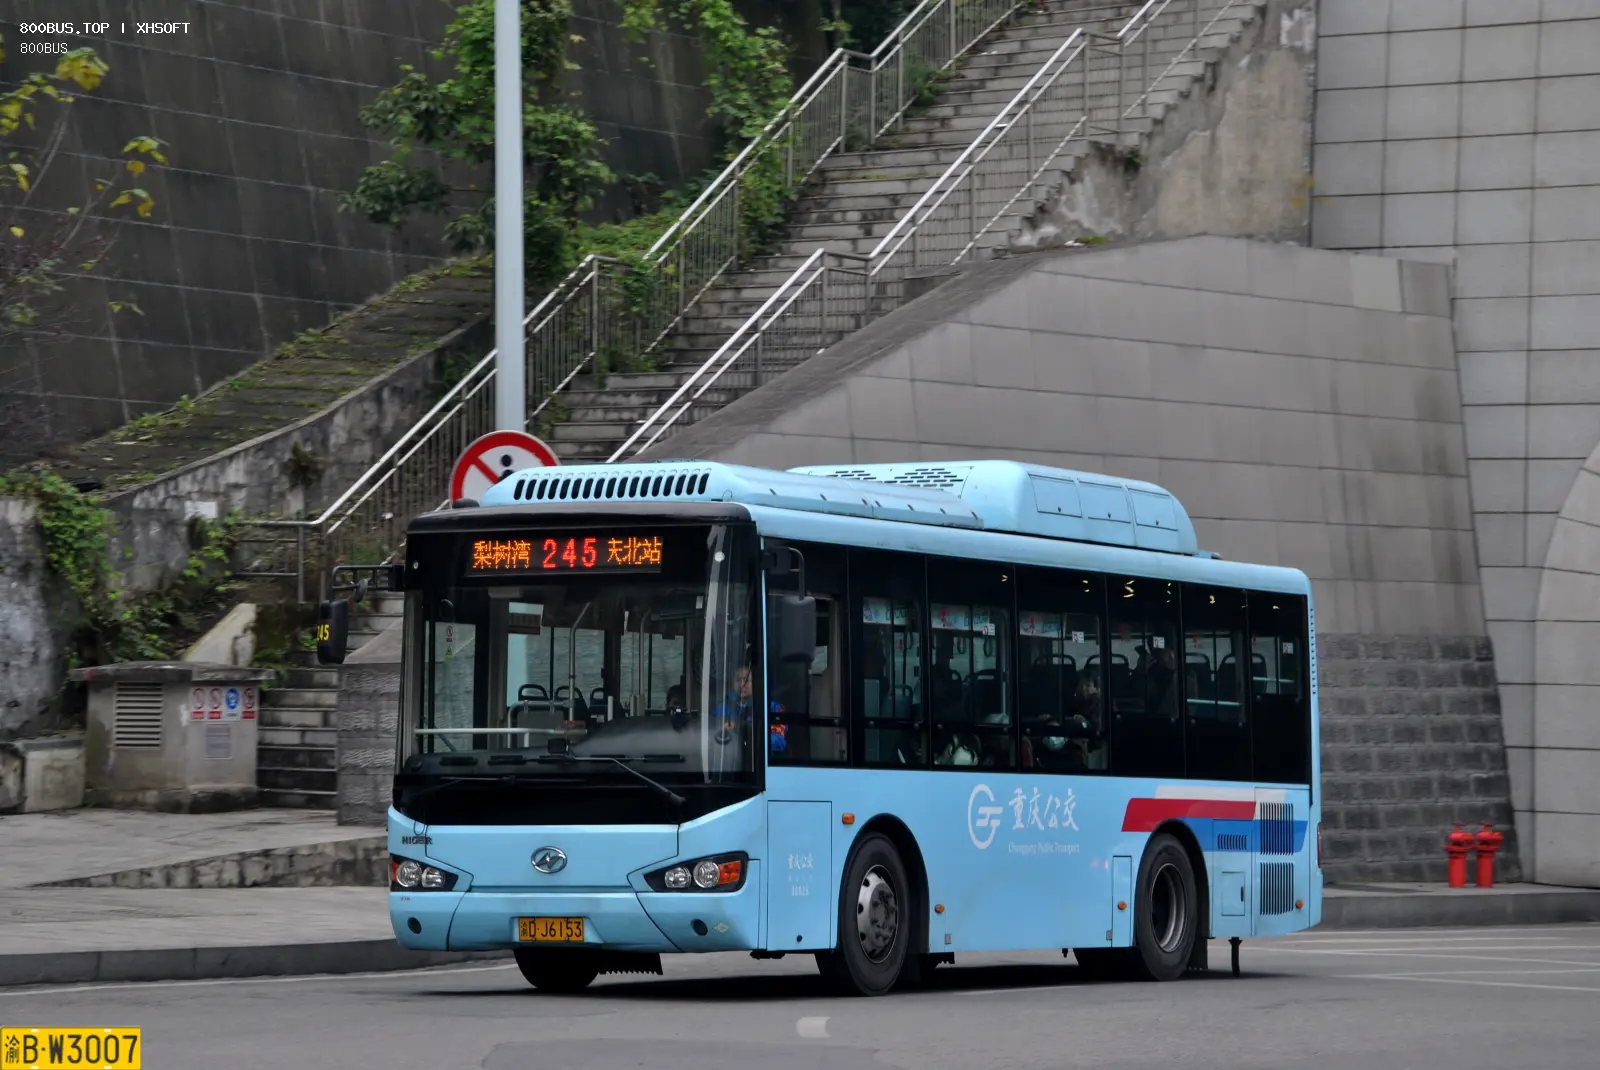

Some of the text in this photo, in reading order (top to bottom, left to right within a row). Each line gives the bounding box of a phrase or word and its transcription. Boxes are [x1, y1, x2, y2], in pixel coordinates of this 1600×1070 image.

[472, 539, 532, 569] 梨树湾
[542, 538, 598, 568] 245
[1008, 786, 1079, 831] 重庆公交
[402, 836, 433, 846] HIGER
[1038, 841, 1054, 854] Public
[1054, 841, 1080, 856] Transport
